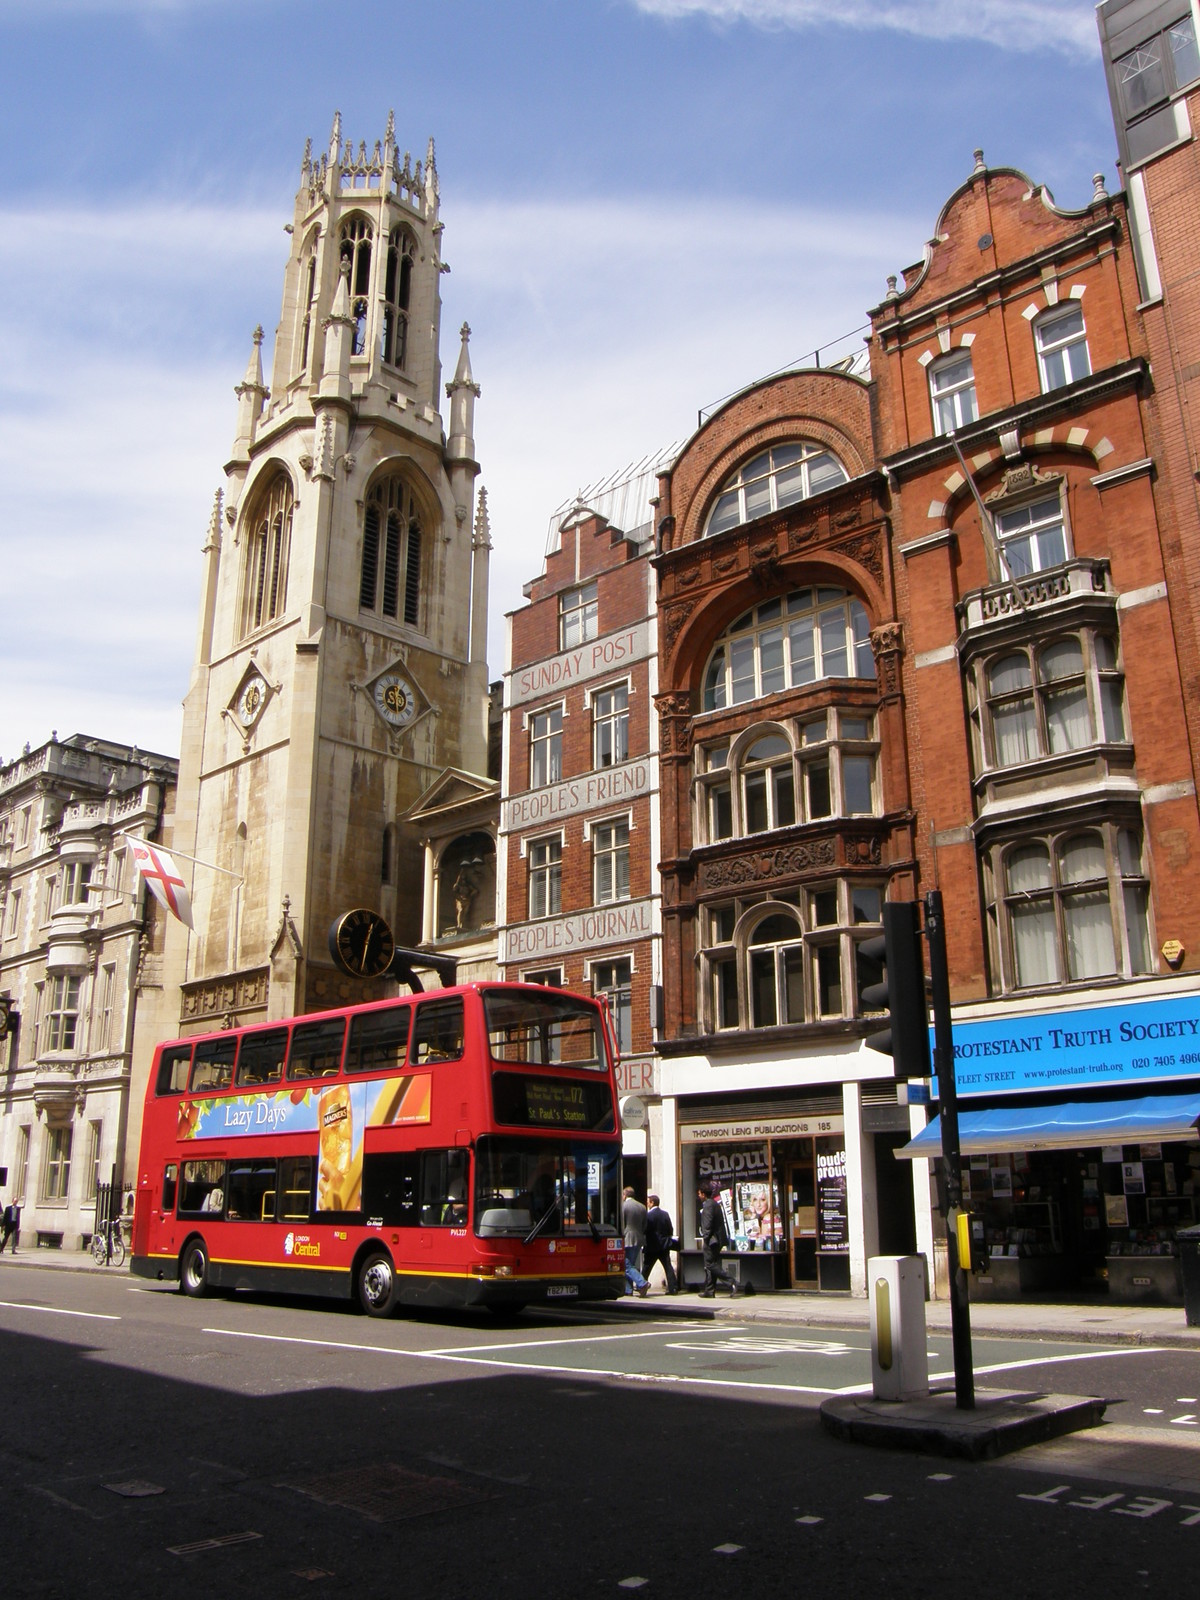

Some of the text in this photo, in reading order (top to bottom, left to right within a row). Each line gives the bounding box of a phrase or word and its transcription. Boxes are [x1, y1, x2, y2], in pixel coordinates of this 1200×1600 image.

[521, 631, 638, 695] SUNDAY POST
[512, 765, 646, 824] PEOPLE'S FRIEND
[509, 906, 650, 955] PEOPLE'S JOURNAL
[953, 1036, 1042, 1059] ROTESTANT
[957, 1073, 982, 1085] FLEET
[984, 1071, 1016, 1083] STREET
[1024, 1062, 1123, 1079] www.protestant-truth.org
[1132, 1057, 1150, 1069] 020
[1153, 1055, 1175, 1067] 7405
[224, 1102, 287, 1132] Lazy Days
[324, 1108, 347, 1124] MAGNERS
[528, 1107, 586, 1121] St Paul's Station
[692, 1122, 831, 1138] THOMSON LENG PUBLICATIONS 185
[700, 1145, 776, 1176] shout
[450, 1229, 467, 1237] PVL227
[294, 1242, 320, 1256] Central
